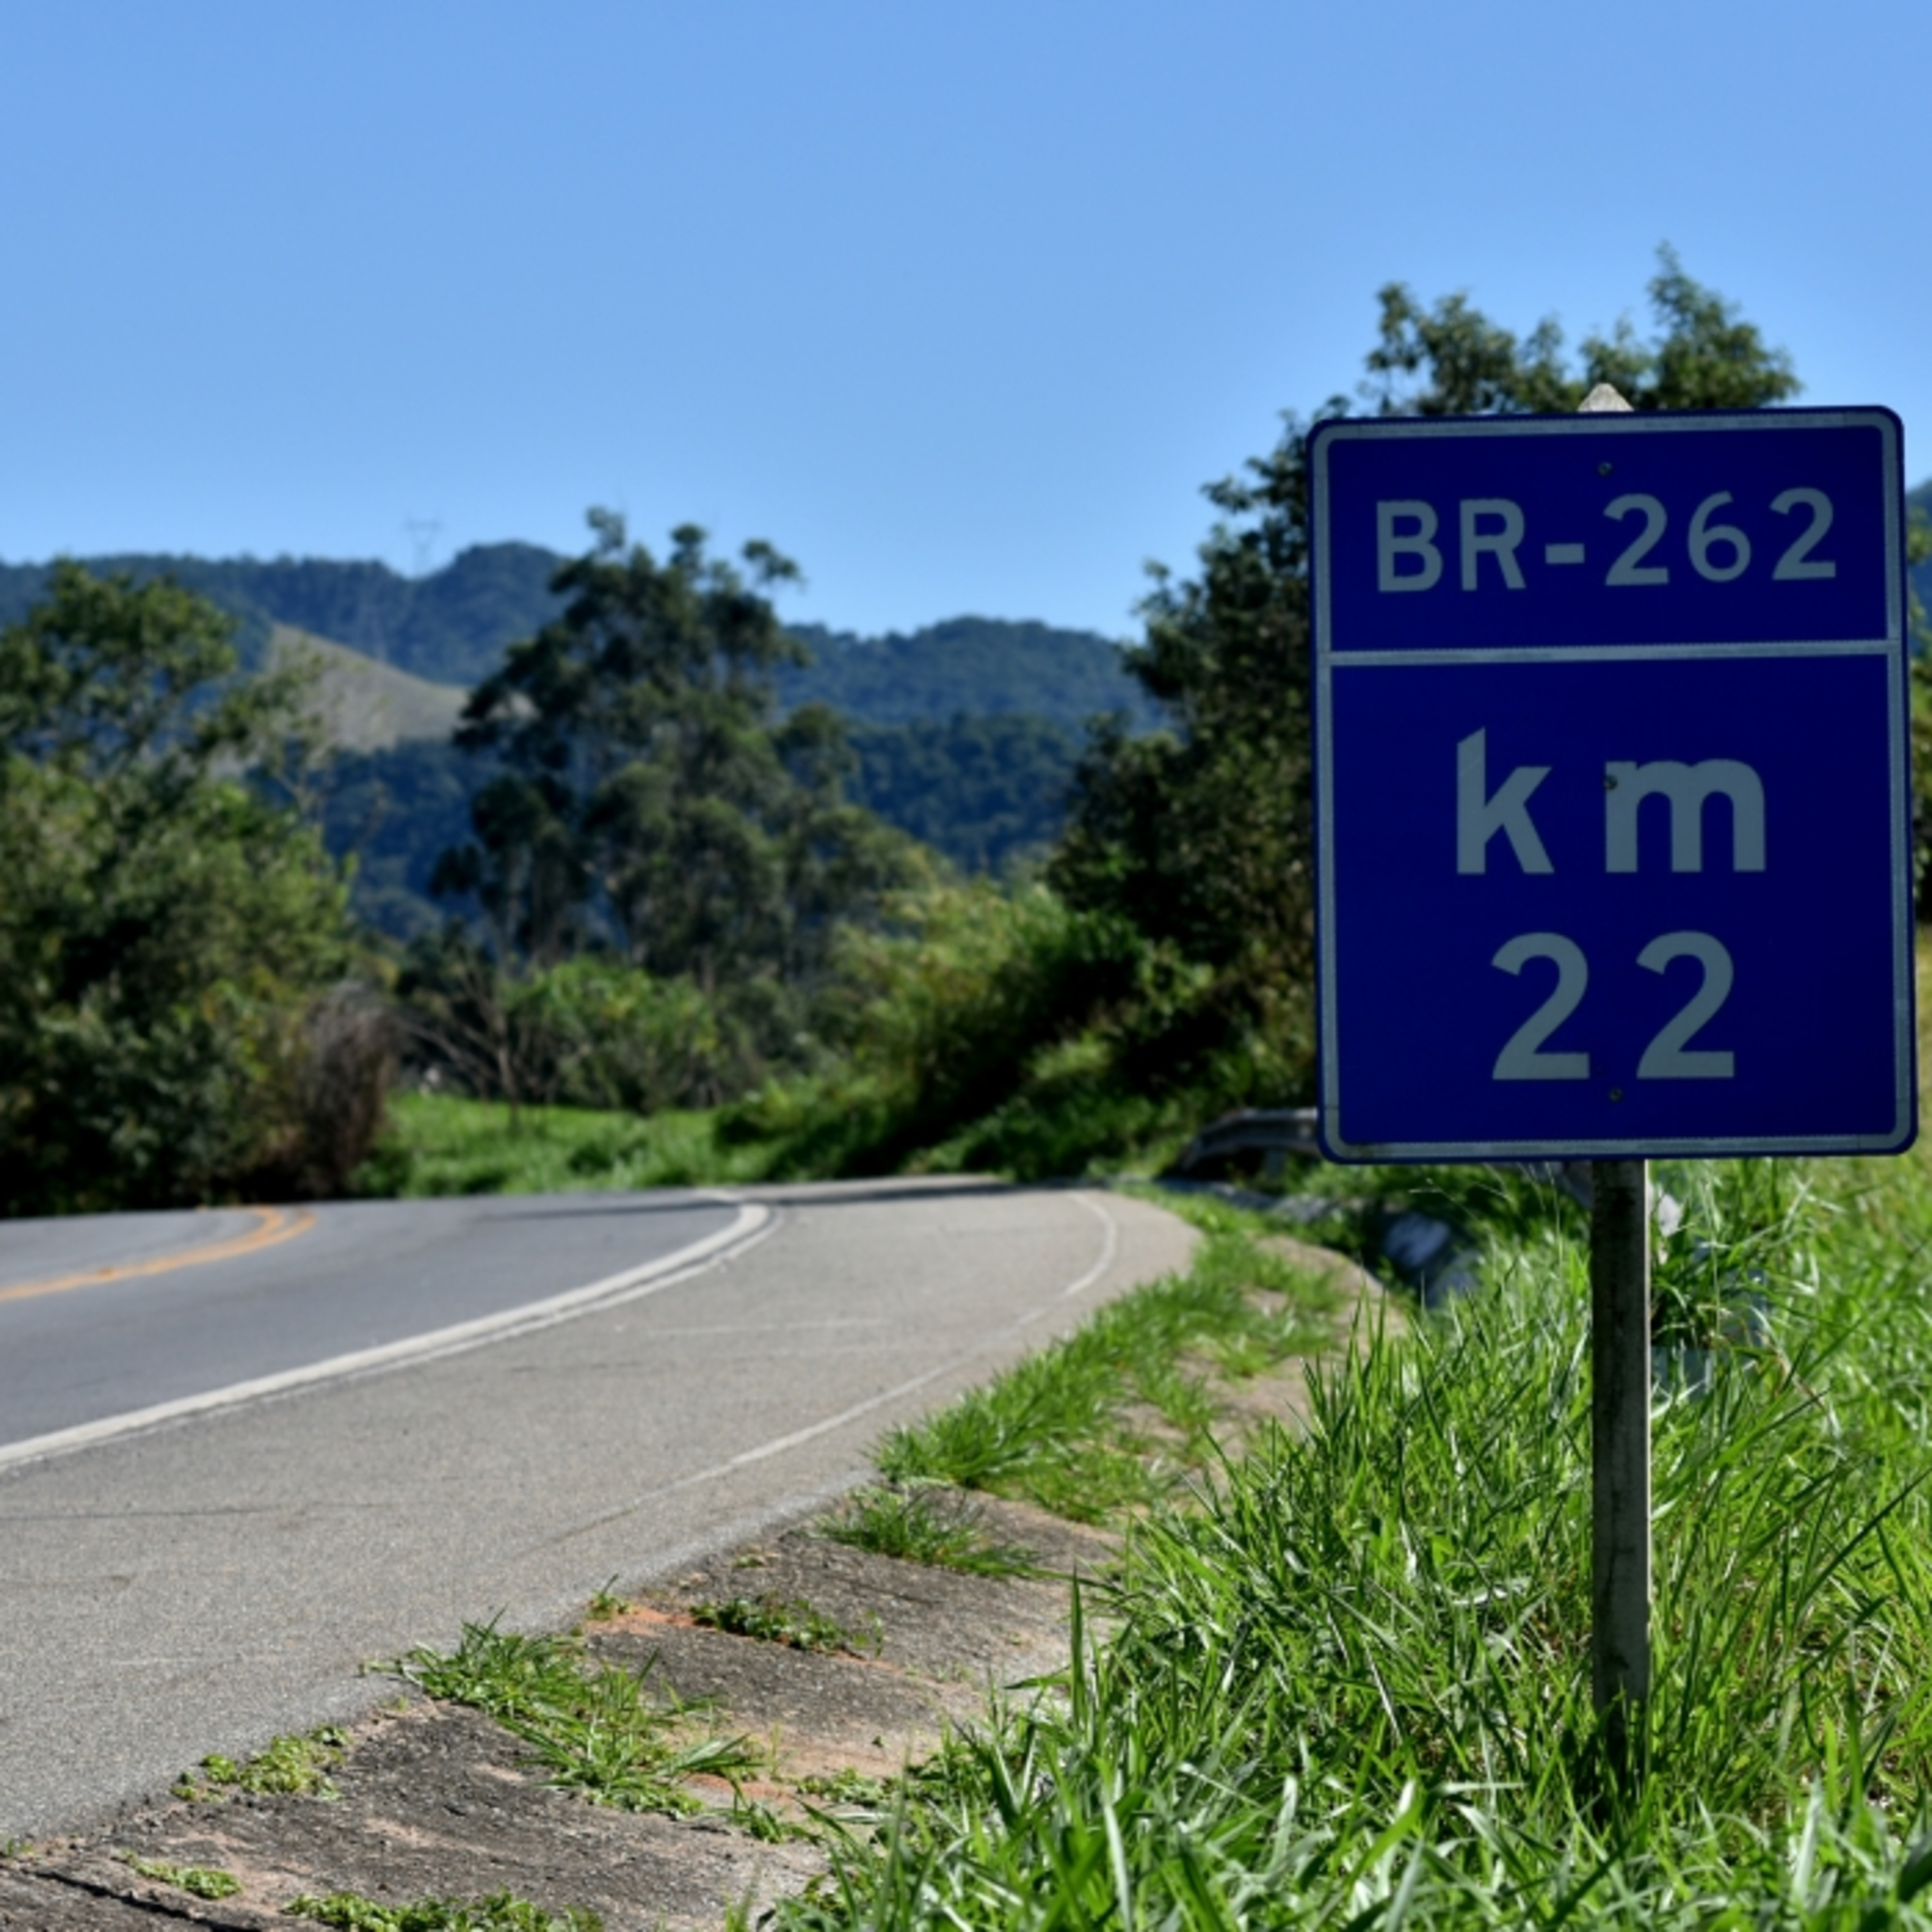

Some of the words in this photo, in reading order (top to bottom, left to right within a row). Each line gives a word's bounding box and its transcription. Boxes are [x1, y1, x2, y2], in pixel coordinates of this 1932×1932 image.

[1376, 487, 1837, 592] BR-262
[1456, 726, 1766, 875] km
[1492, 931, 1735, 1081] 22
